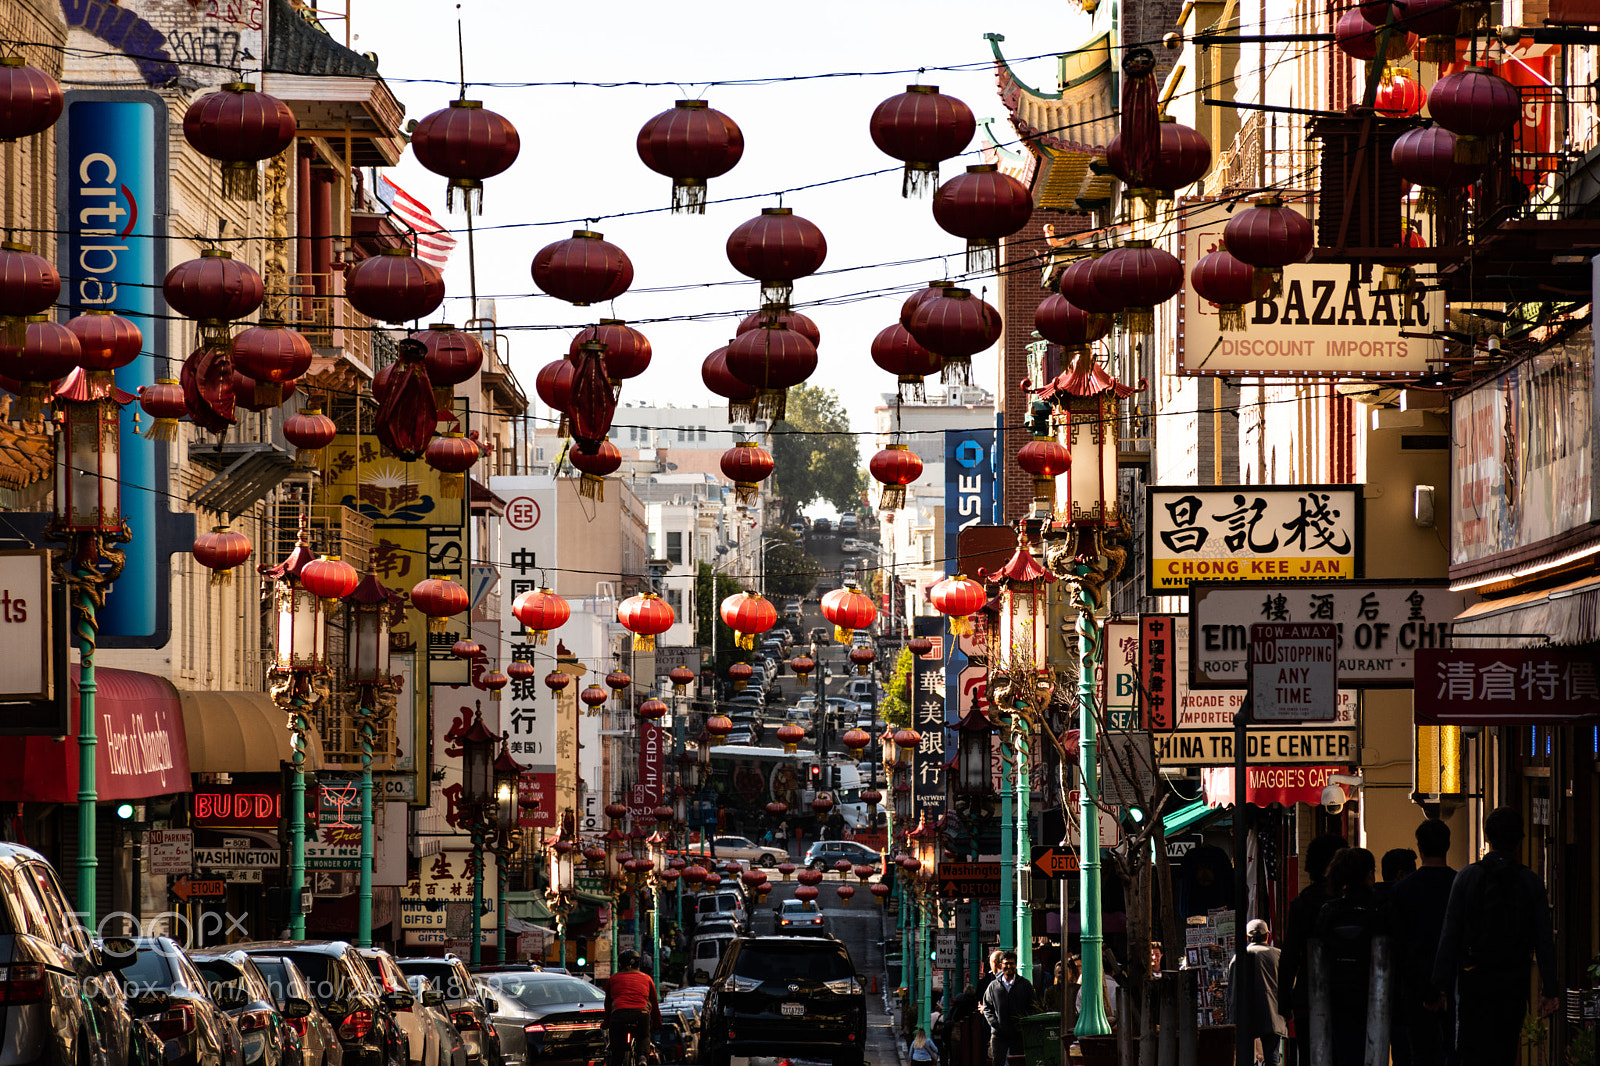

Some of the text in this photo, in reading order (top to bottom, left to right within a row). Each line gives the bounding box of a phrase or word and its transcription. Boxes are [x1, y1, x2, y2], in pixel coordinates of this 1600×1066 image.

[1251, 279, 1430, 327] BAZAAR
[1221, 340, 1409, 358] DISCOUNT IMPORTS
[958, 474, 982, 532] ASE
[1160, 492, 1351, 554] 昌記棧
[1168, 560, 1340, 574] CHONG KEE JAN
[1256, 626, 1331, 638] TOW-AWAY
[1355, 622, 1391, 649] OF
[1399, 622, 1454, 649] CHI
[1253, 641, 1332, 663] NO STOPPING
[1203, 658, 1394, 673] ROOF AURANT
[1277, 667, 1310, 684] ANY
[1436, 660, 1600, 701] 清倉特價
[1180, 696, 1225, 708] ARCADE
[1275, 687, 1312, 704] TIME
[103, 713, 133, 776] Heart
[510, 741, 543, 754] 美国)
[1209, 735, 1271, 759] TRDE
[1277, 735, 1350, 758] CENTER
[644, 728, 658, 803] SHISEIDO
[1249, 768, 1340, 789] MAGGIE'S CAF
[385, 781, 405, 793] CO.
[195, 793, 281, 818] BUDD
[342, 814, 362, 822] DIFFER
[150, 831, 190, 844] NO PARKING
[332, 829, 362, 844] Free
[194, 852, 278, 864] WASHINGTON
[313, 860, 341, 868] WONDER
[343, 859, 351, 867] OF
[354, 859, 362, 867] TE
[1051, 856, 1080, 869] DETO
[942, 865, 1001, 878] Washingto
[191, 882, 221, 894] ETOUR
[960, 883, 1001, 895] DETOU
[404, 915, 443, 924] GIFTS &
[418, 934, 445, 942] GIFTS
